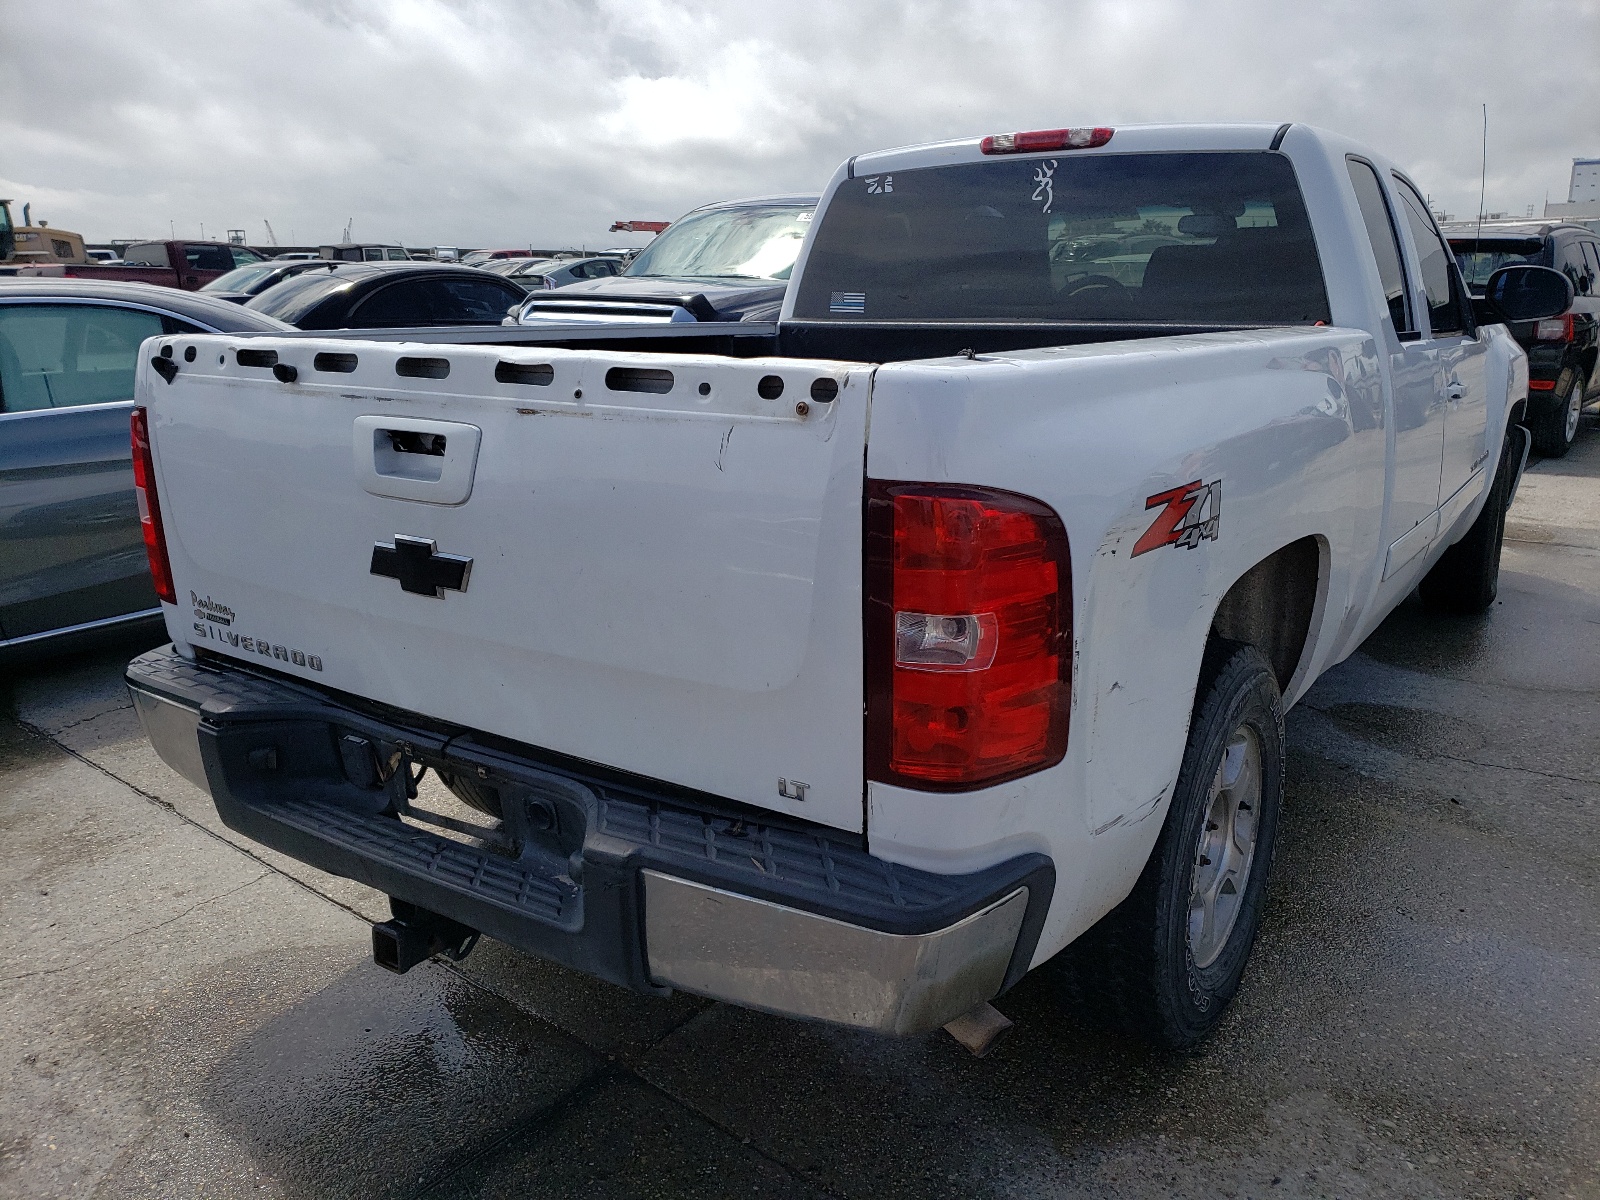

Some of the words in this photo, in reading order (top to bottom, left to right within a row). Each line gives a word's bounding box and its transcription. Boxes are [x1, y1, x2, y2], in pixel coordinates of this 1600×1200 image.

[1129, 479, 1221, 559] Z71
[193, 621, 323, 672] SILVERADO
[778, 776, 811, 802] LT
